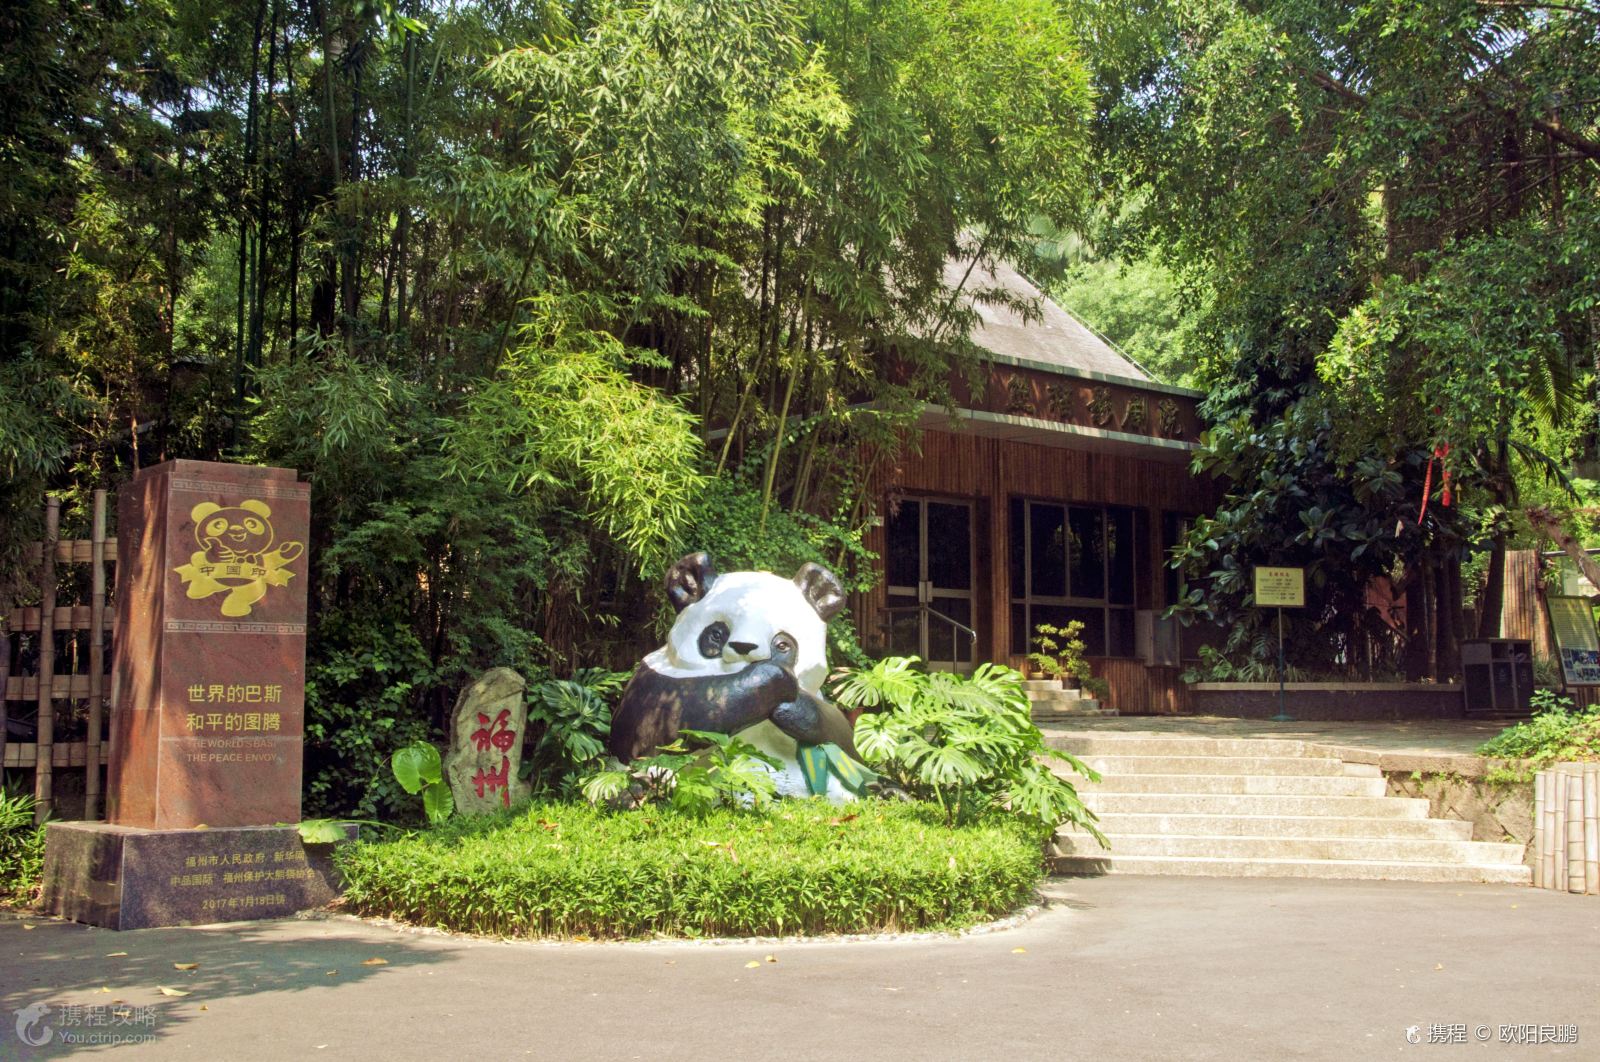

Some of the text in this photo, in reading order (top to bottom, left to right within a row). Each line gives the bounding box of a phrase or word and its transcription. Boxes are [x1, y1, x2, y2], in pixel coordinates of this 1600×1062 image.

[200, 565, 267, 577] 中国印
[187, 684, 282, 703] 世界的巴斯
[186, 712, 281, 731] 和平的图腾
[207, 740, 252, 748] WORLDS
[186, 753, 277, 762] THE PEACE ENVOY
[470, 708, 517, 809] 福州
[185, 852, 266, 868] 福州市人民政府
